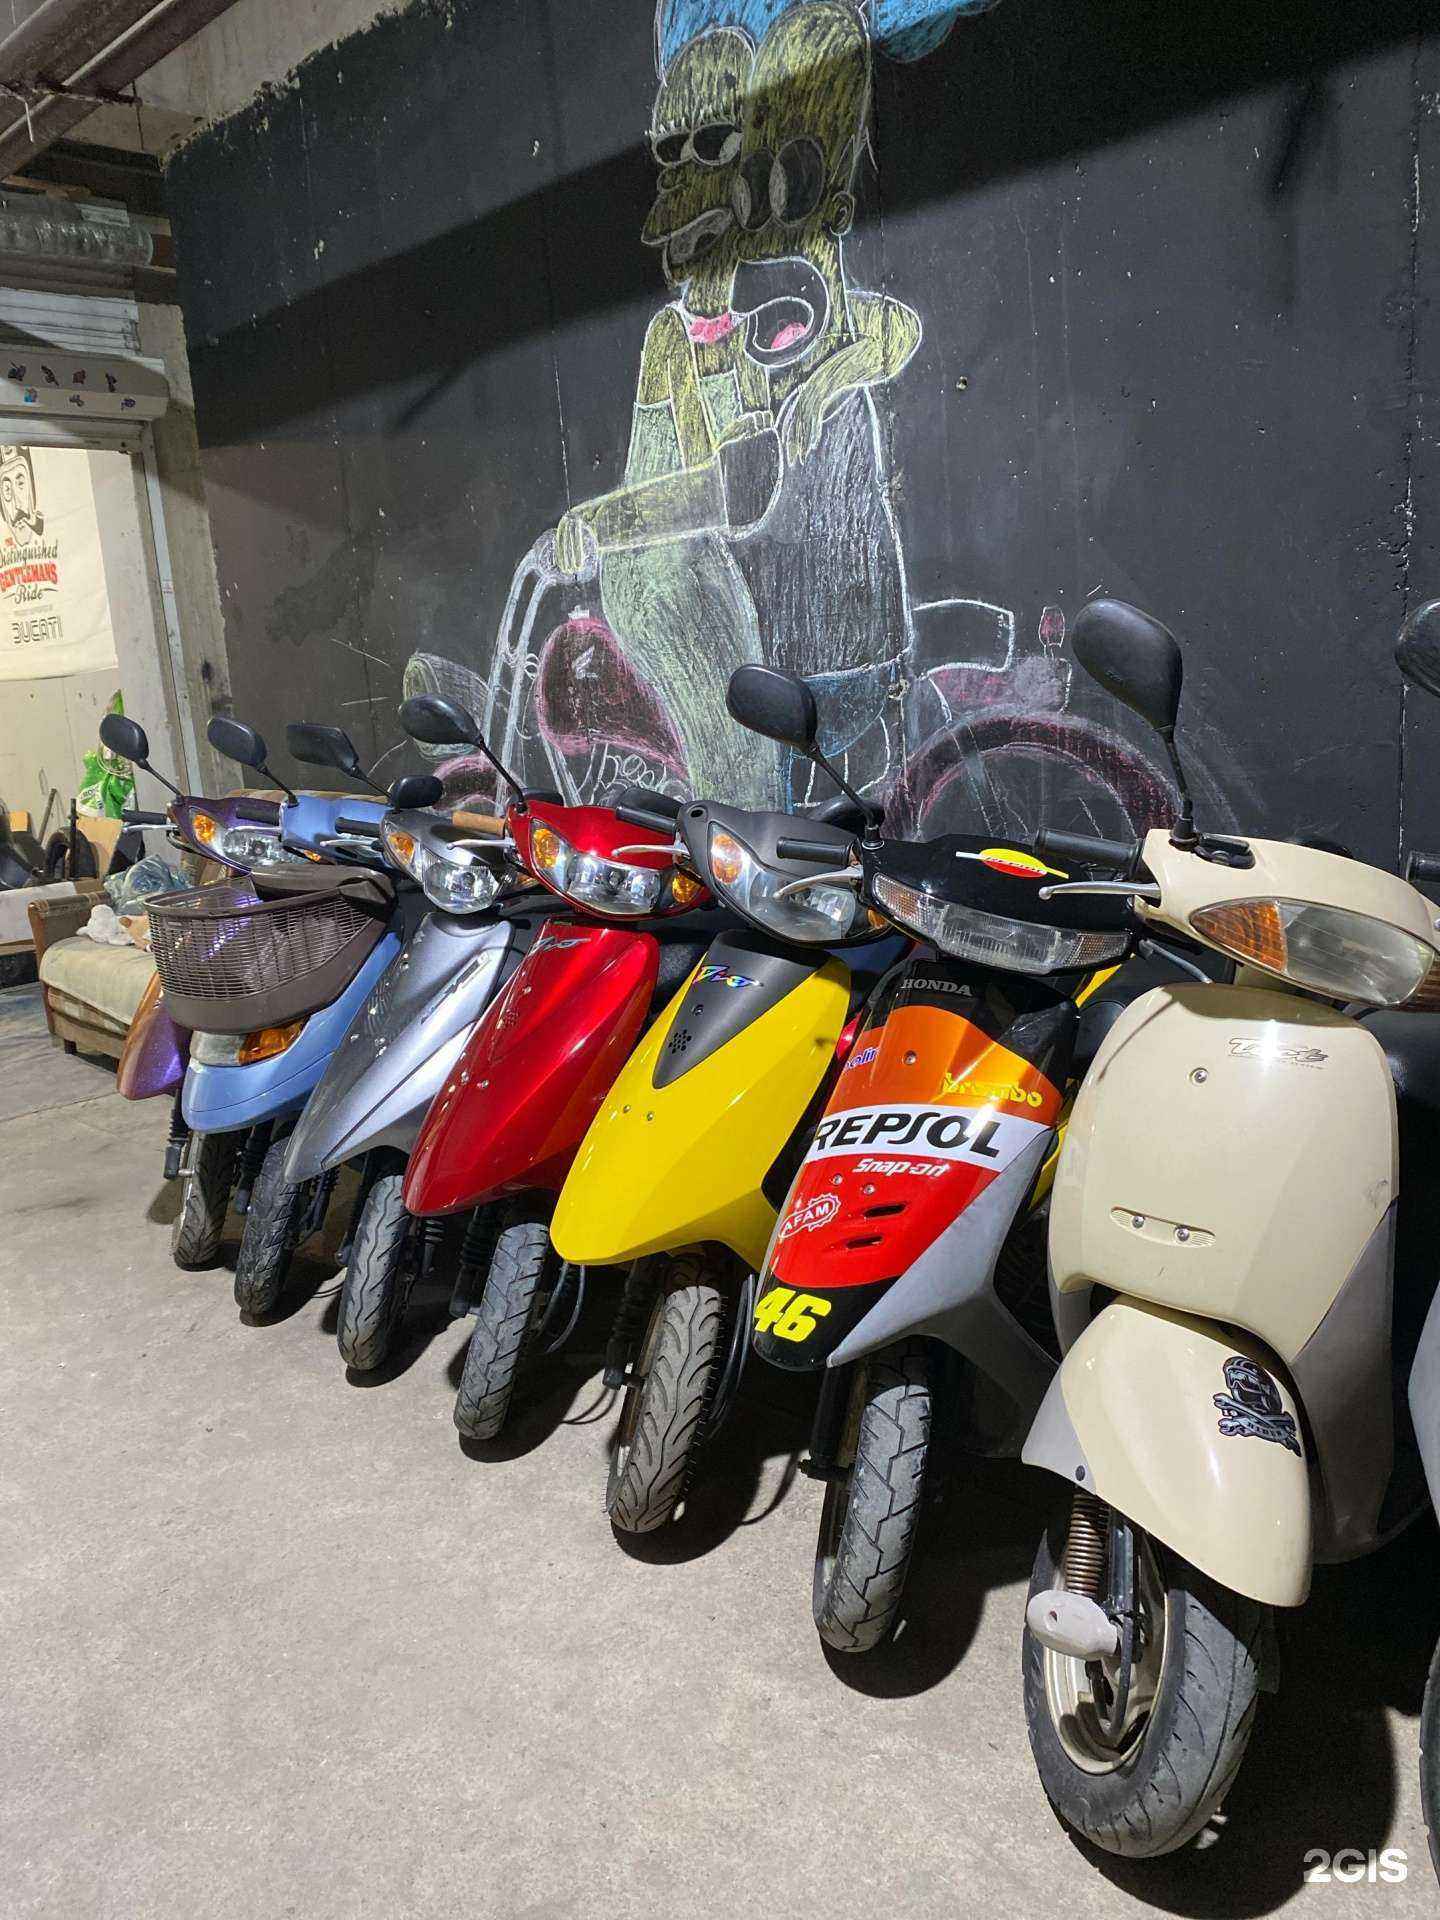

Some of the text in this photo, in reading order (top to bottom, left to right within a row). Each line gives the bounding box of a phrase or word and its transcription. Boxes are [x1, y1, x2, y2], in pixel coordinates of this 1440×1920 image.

[14, 583, 45, 604] Ride
[900, 978, 973, 997] HONDA
[942, 1072, 1043, 1108] brbo
[814, 1111, 1001, 1158] REPSOL
[852, 1158, 951, 1177] Snap-on
[783, 1202, 831, 1233] AFAM
[754, 1287, 832, 1342] 46
